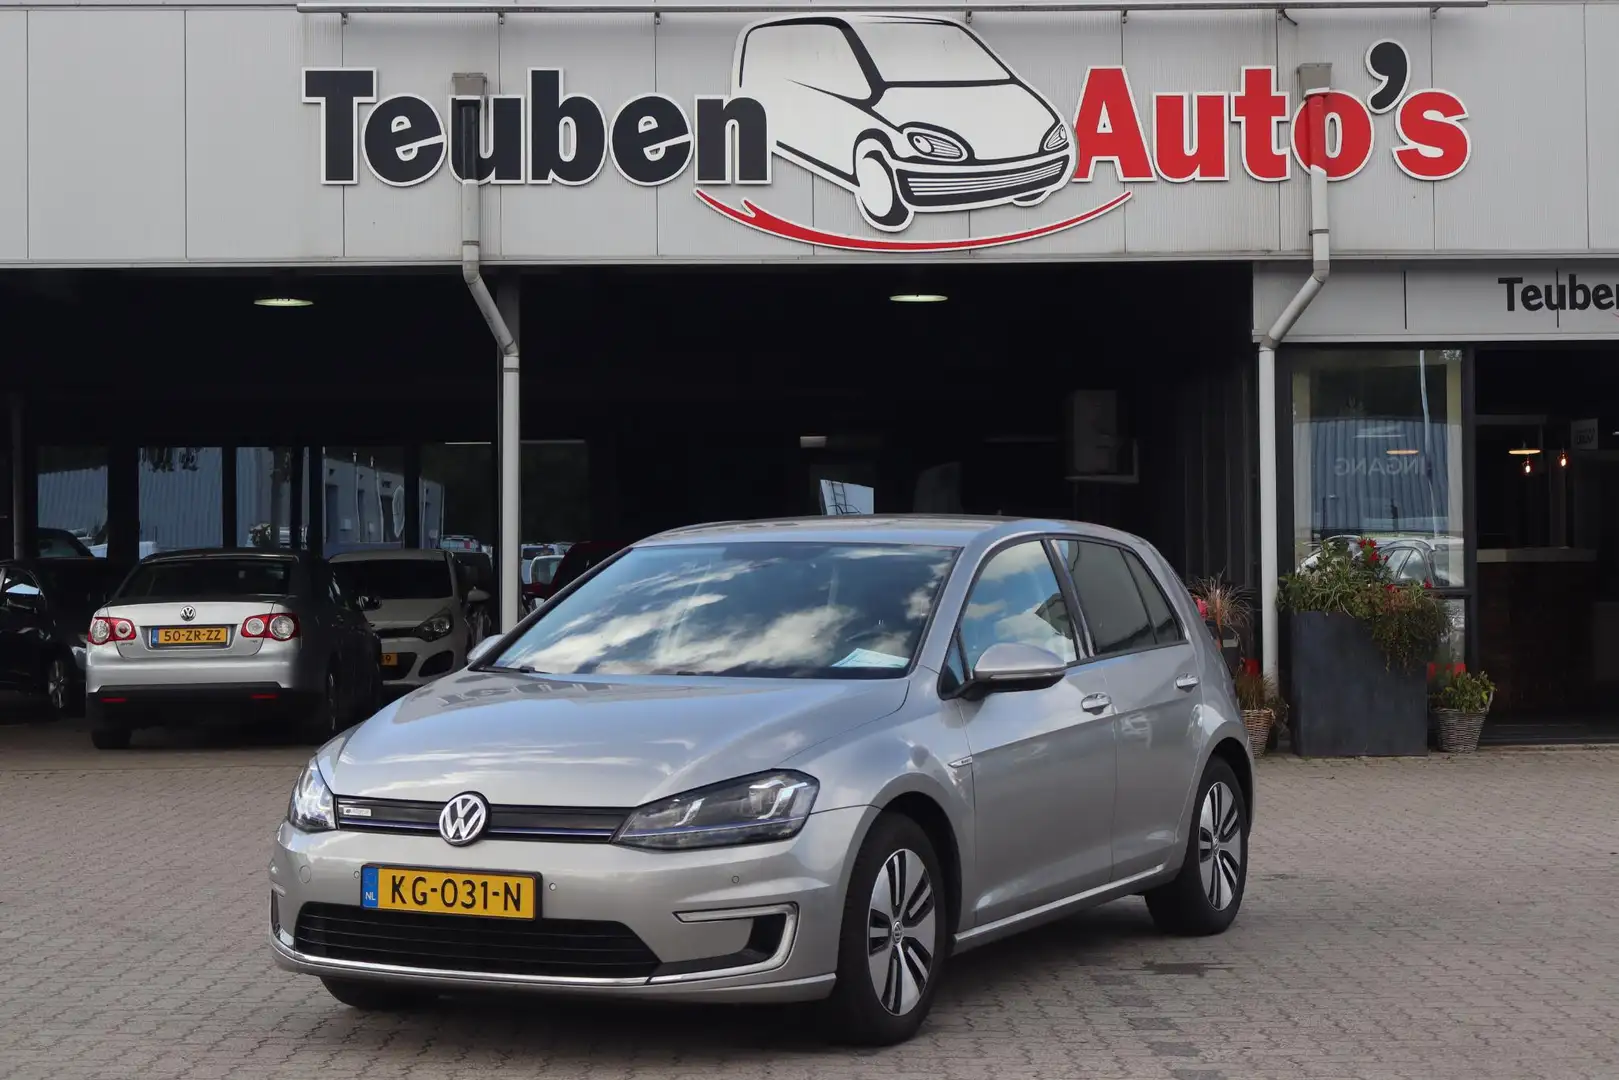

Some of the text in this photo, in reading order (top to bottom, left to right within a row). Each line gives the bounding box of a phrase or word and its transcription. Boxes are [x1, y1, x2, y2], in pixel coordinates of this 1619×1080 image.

[302, 38, 1471, 187] Teuben Auto's
[1498, 273, 1619, 311] Teube
[164, 630, 221, 642] 50-ZR-ZZ
[365, 875, 521, 912] NL KG-031-N
